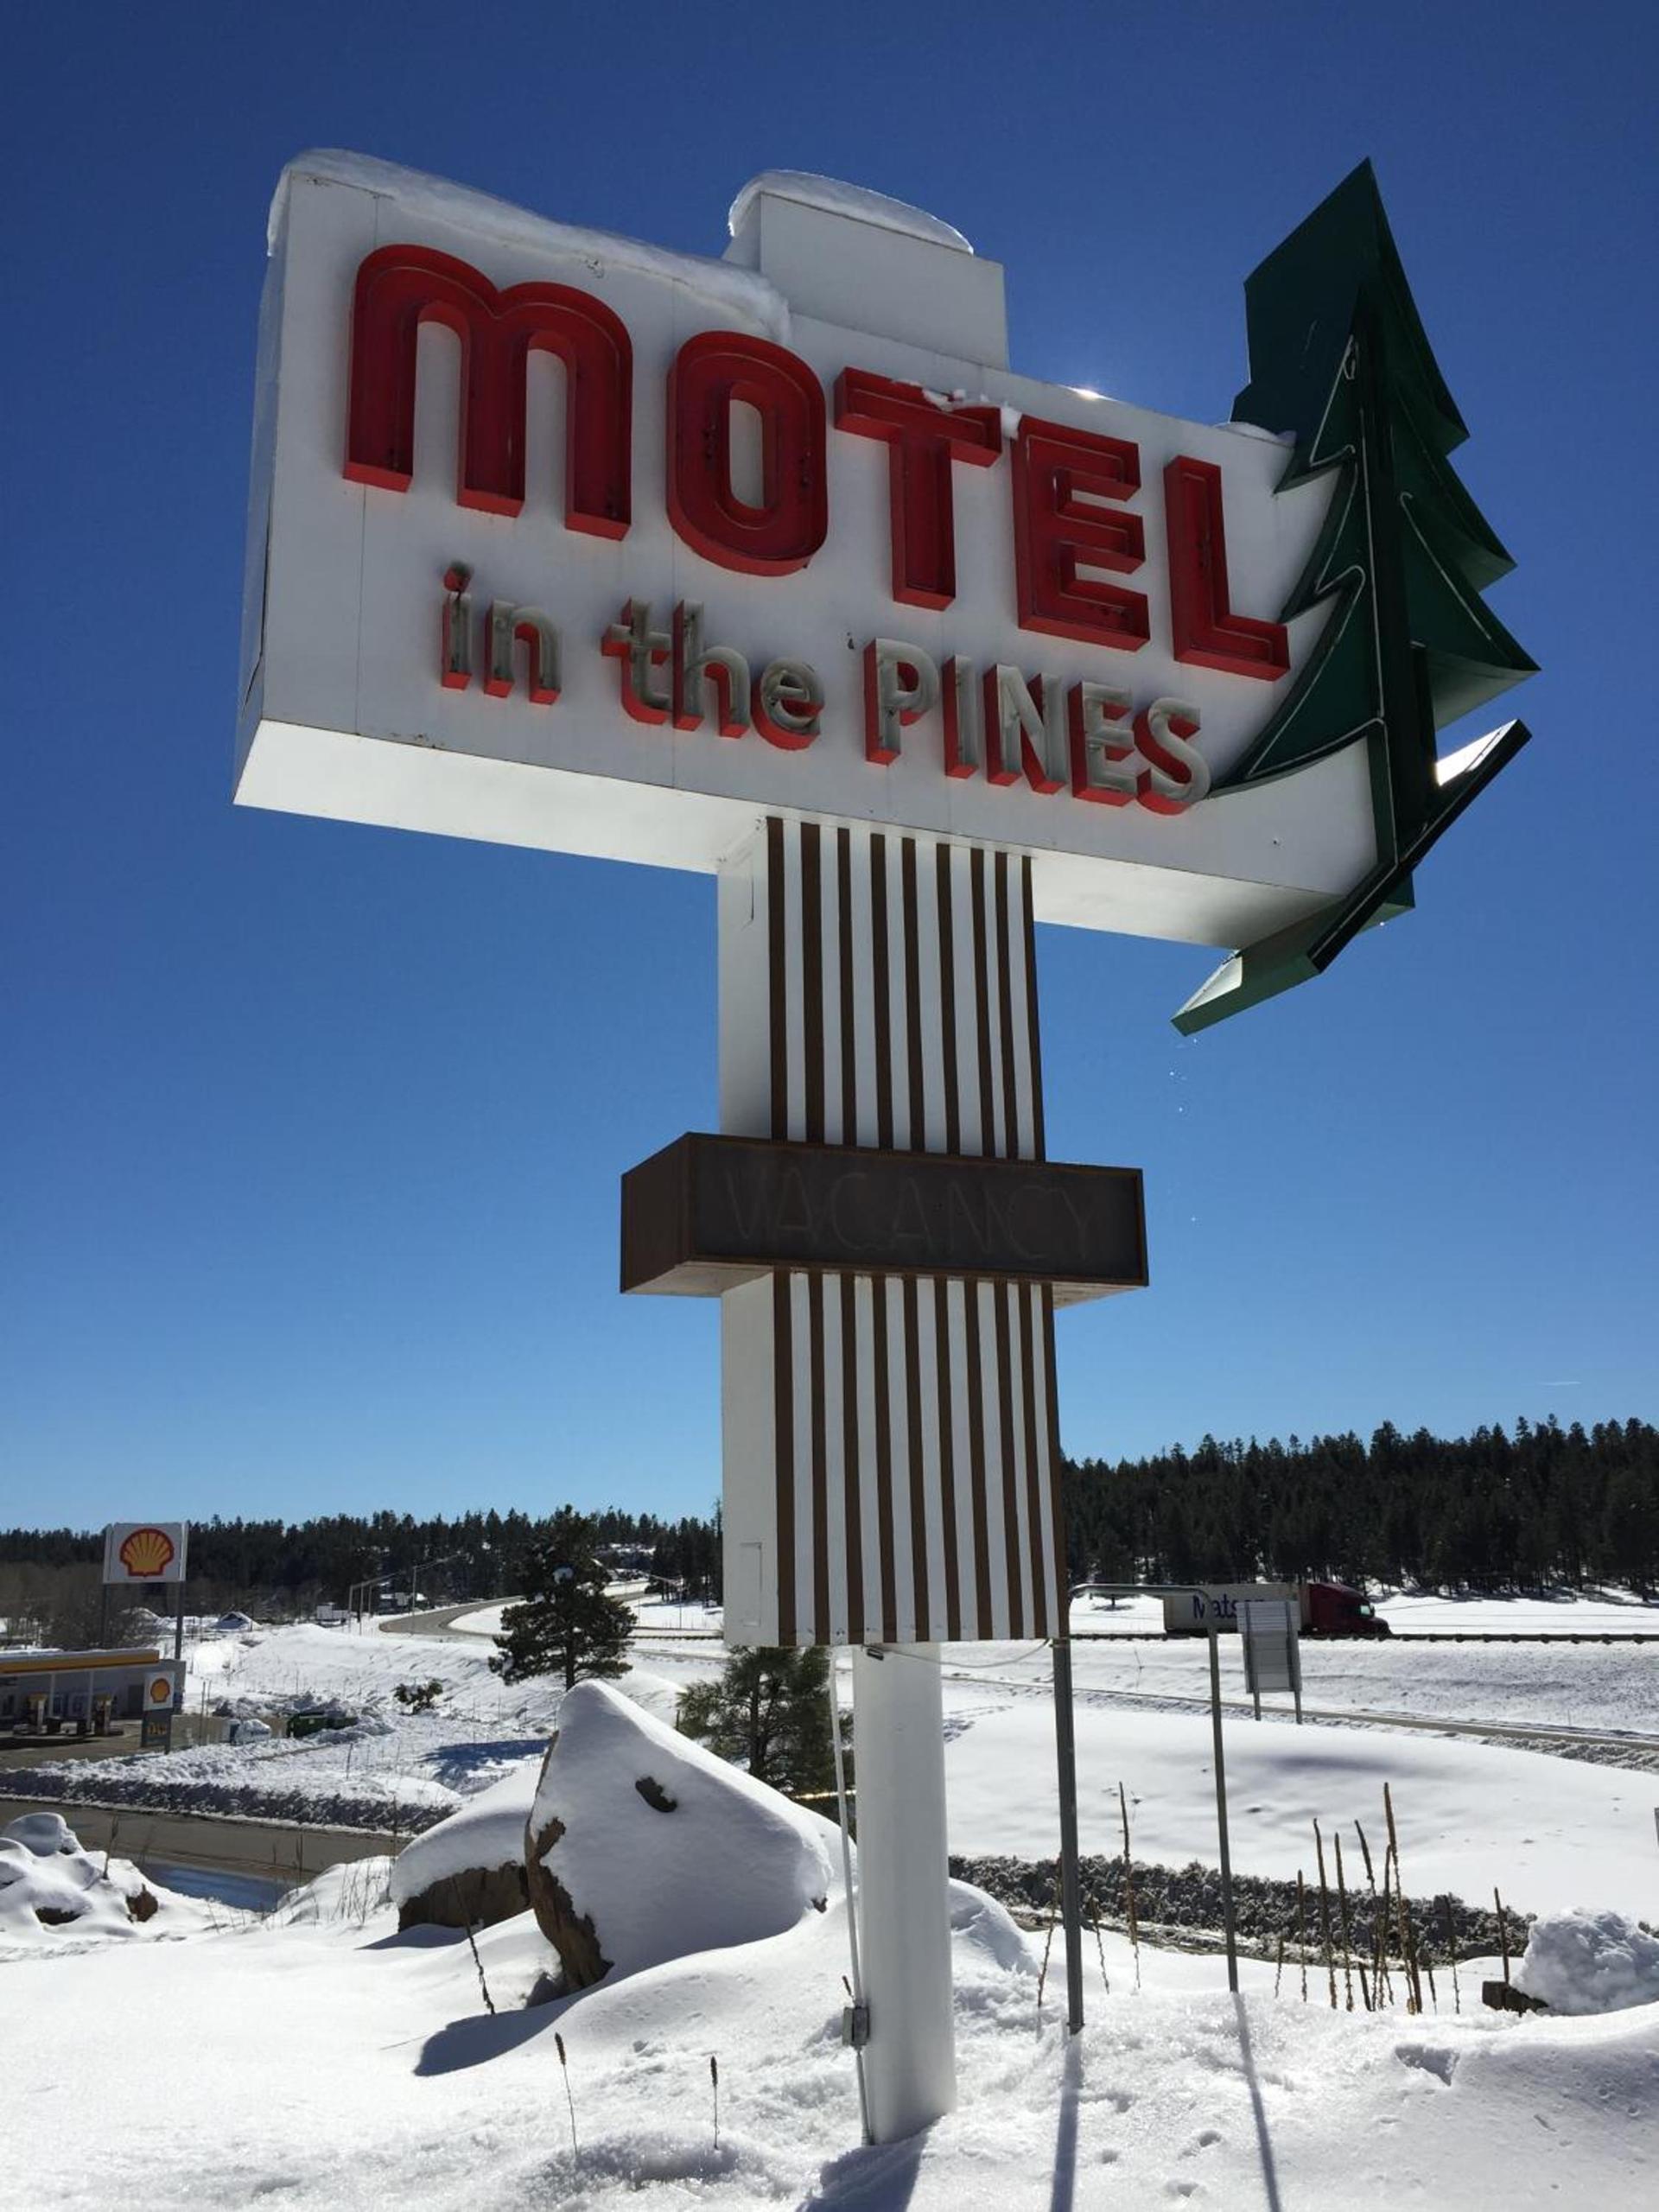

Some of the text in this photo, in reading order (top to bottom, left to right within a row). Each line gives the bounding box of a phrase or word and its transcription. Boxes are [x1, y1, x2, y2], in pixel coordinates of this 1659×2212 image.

[344, 244, 1292, 681] MOTEL
[440, 563, 1212, 815] in the PINES
[722, 1165, 1095, 1262] VACANCY
